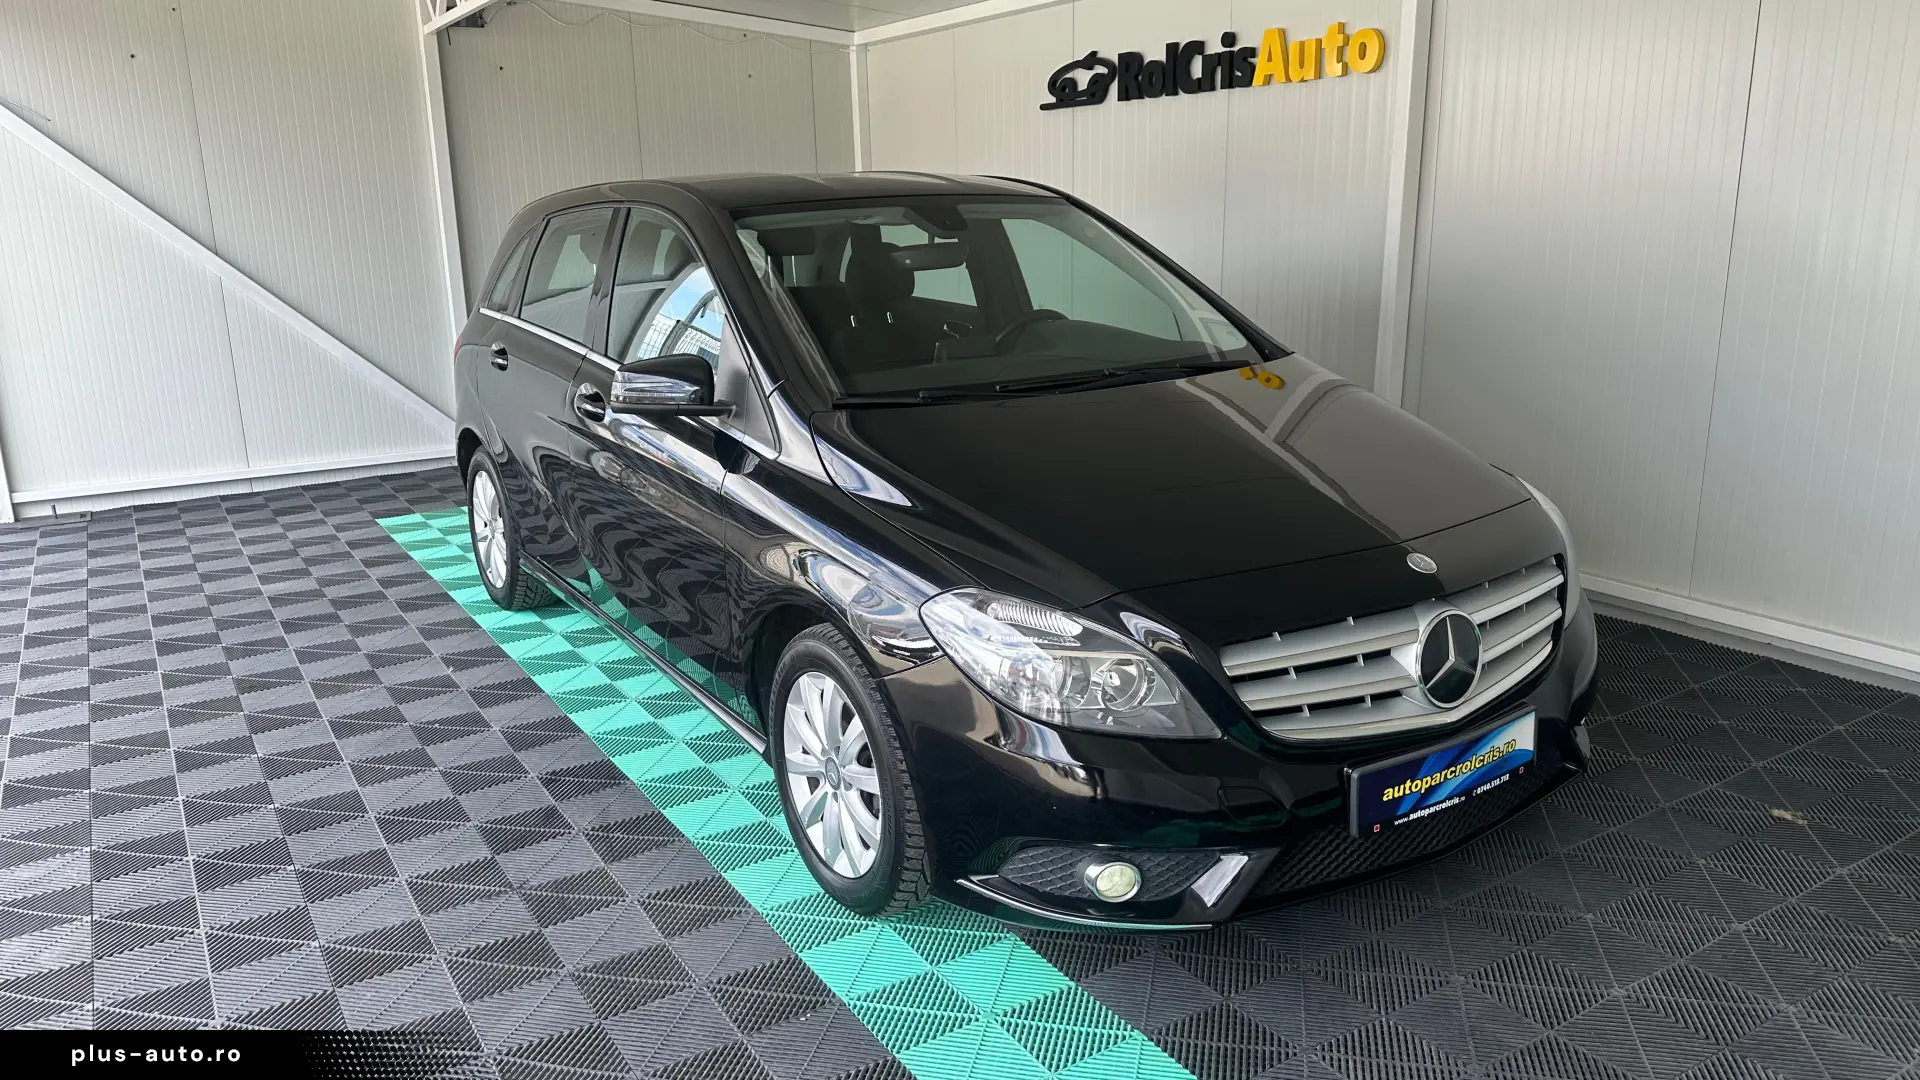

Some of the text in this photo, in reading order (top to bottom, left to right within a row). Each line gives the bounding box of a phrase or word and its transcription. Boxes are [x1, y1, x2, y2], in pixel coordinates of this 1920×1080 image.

[1117, 22, 1386, 102] RolCrisAuto
[1382, 739, 1517, 802] autoparcrolcris.ro
[1394, 796, 1466, 826] www.autoparcrolcris.ro
